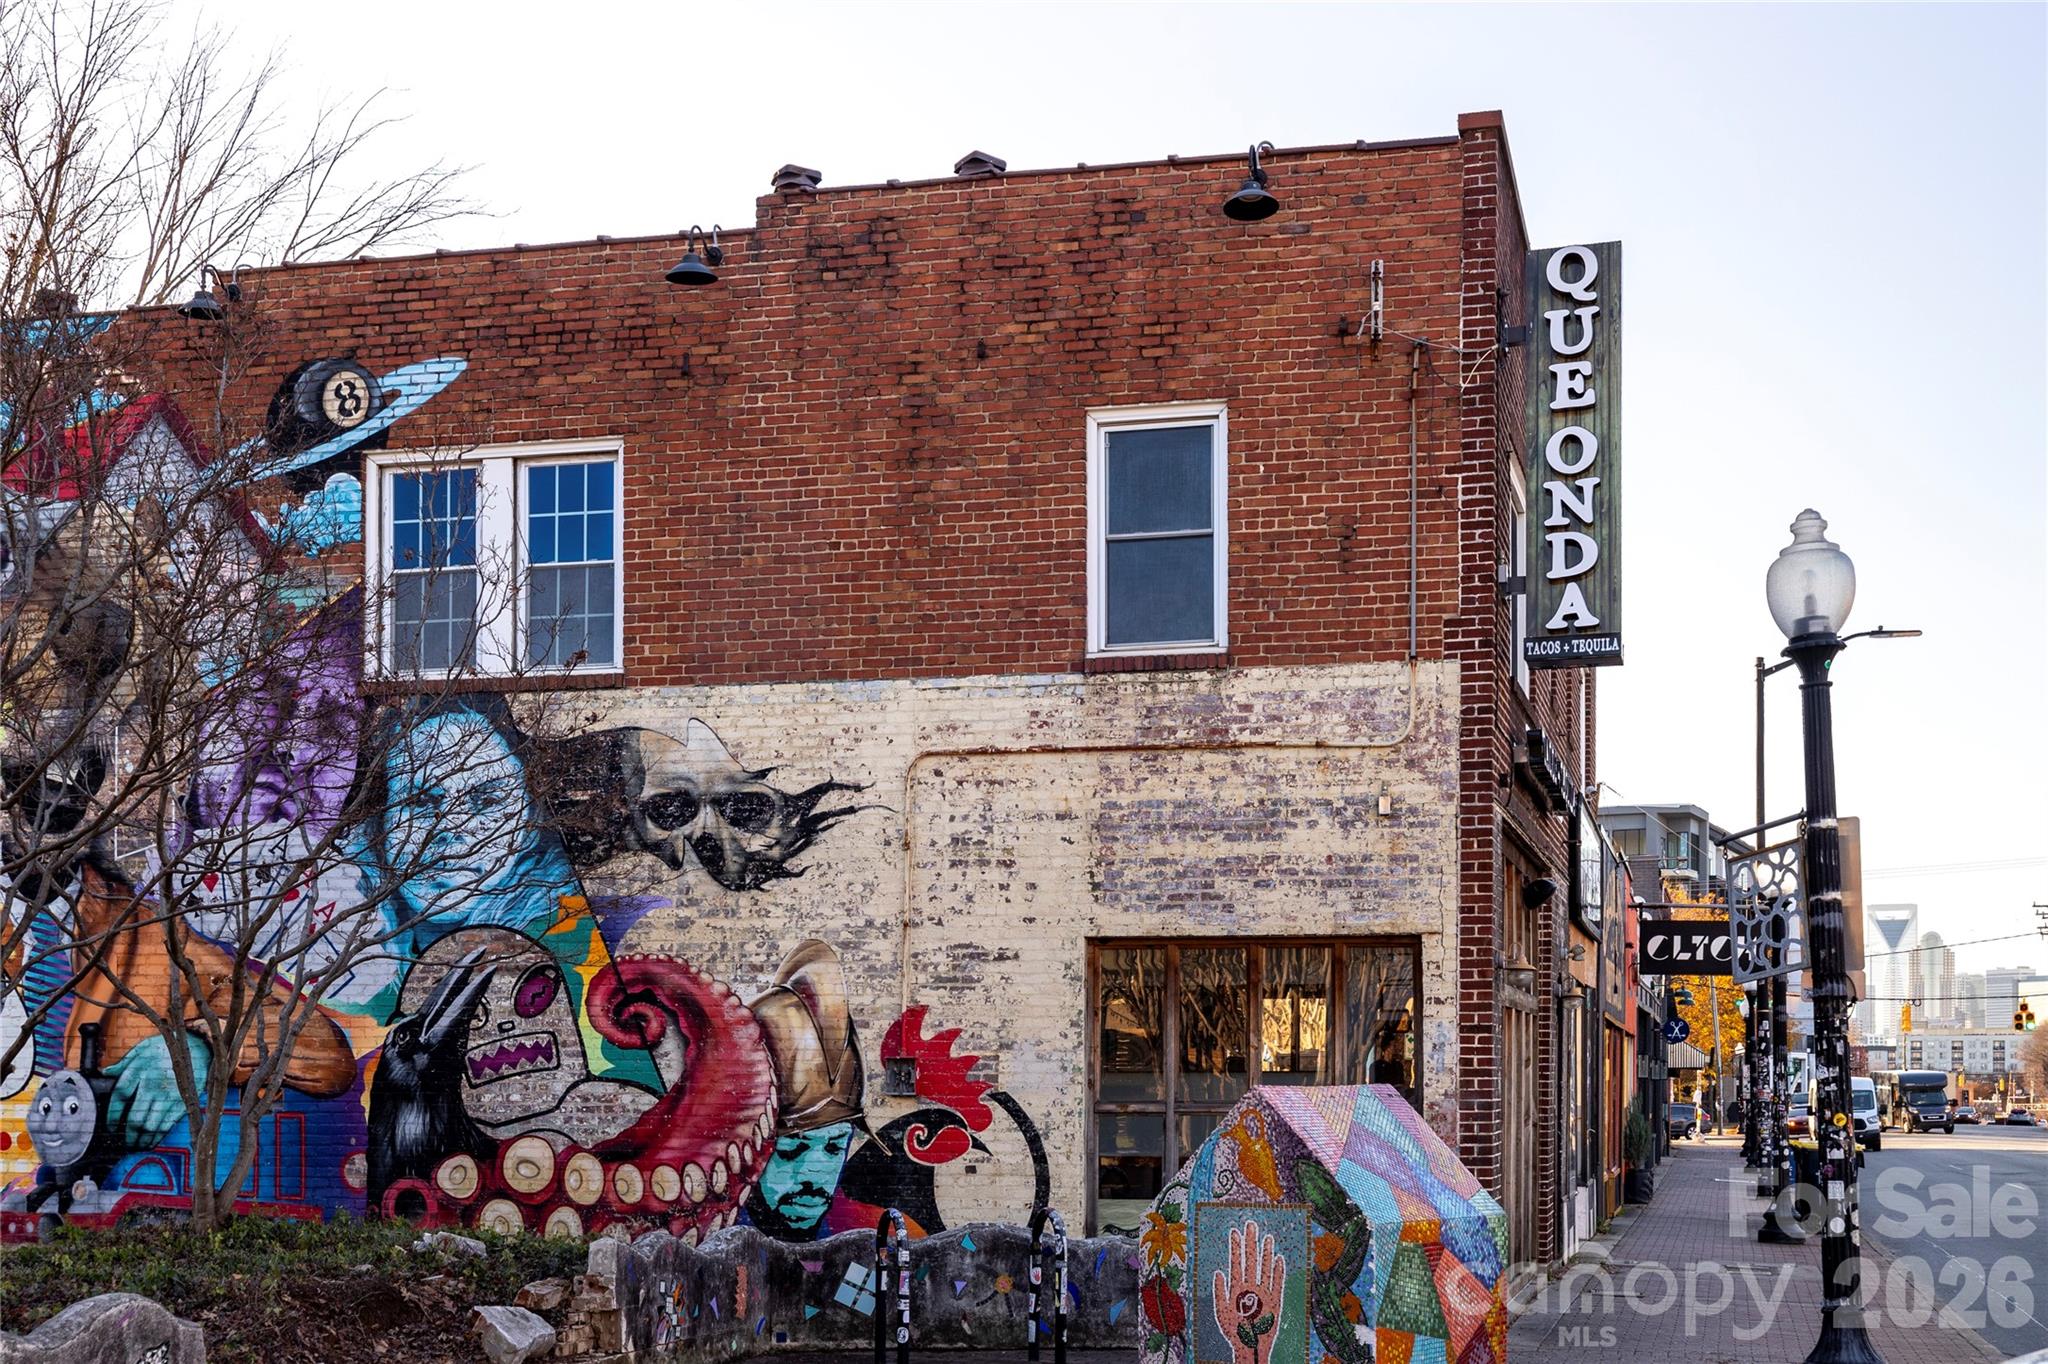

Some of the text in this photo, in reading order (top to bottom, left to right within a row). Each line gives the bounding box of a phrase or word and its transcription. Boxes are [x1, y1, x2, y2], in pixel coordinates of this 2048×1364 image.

[333, 380, 362, 418] 8
[1544, 245, 1600, 630] QUE ONDA
[1526, 638, 1619, 655] TACOS + TEQUILA
